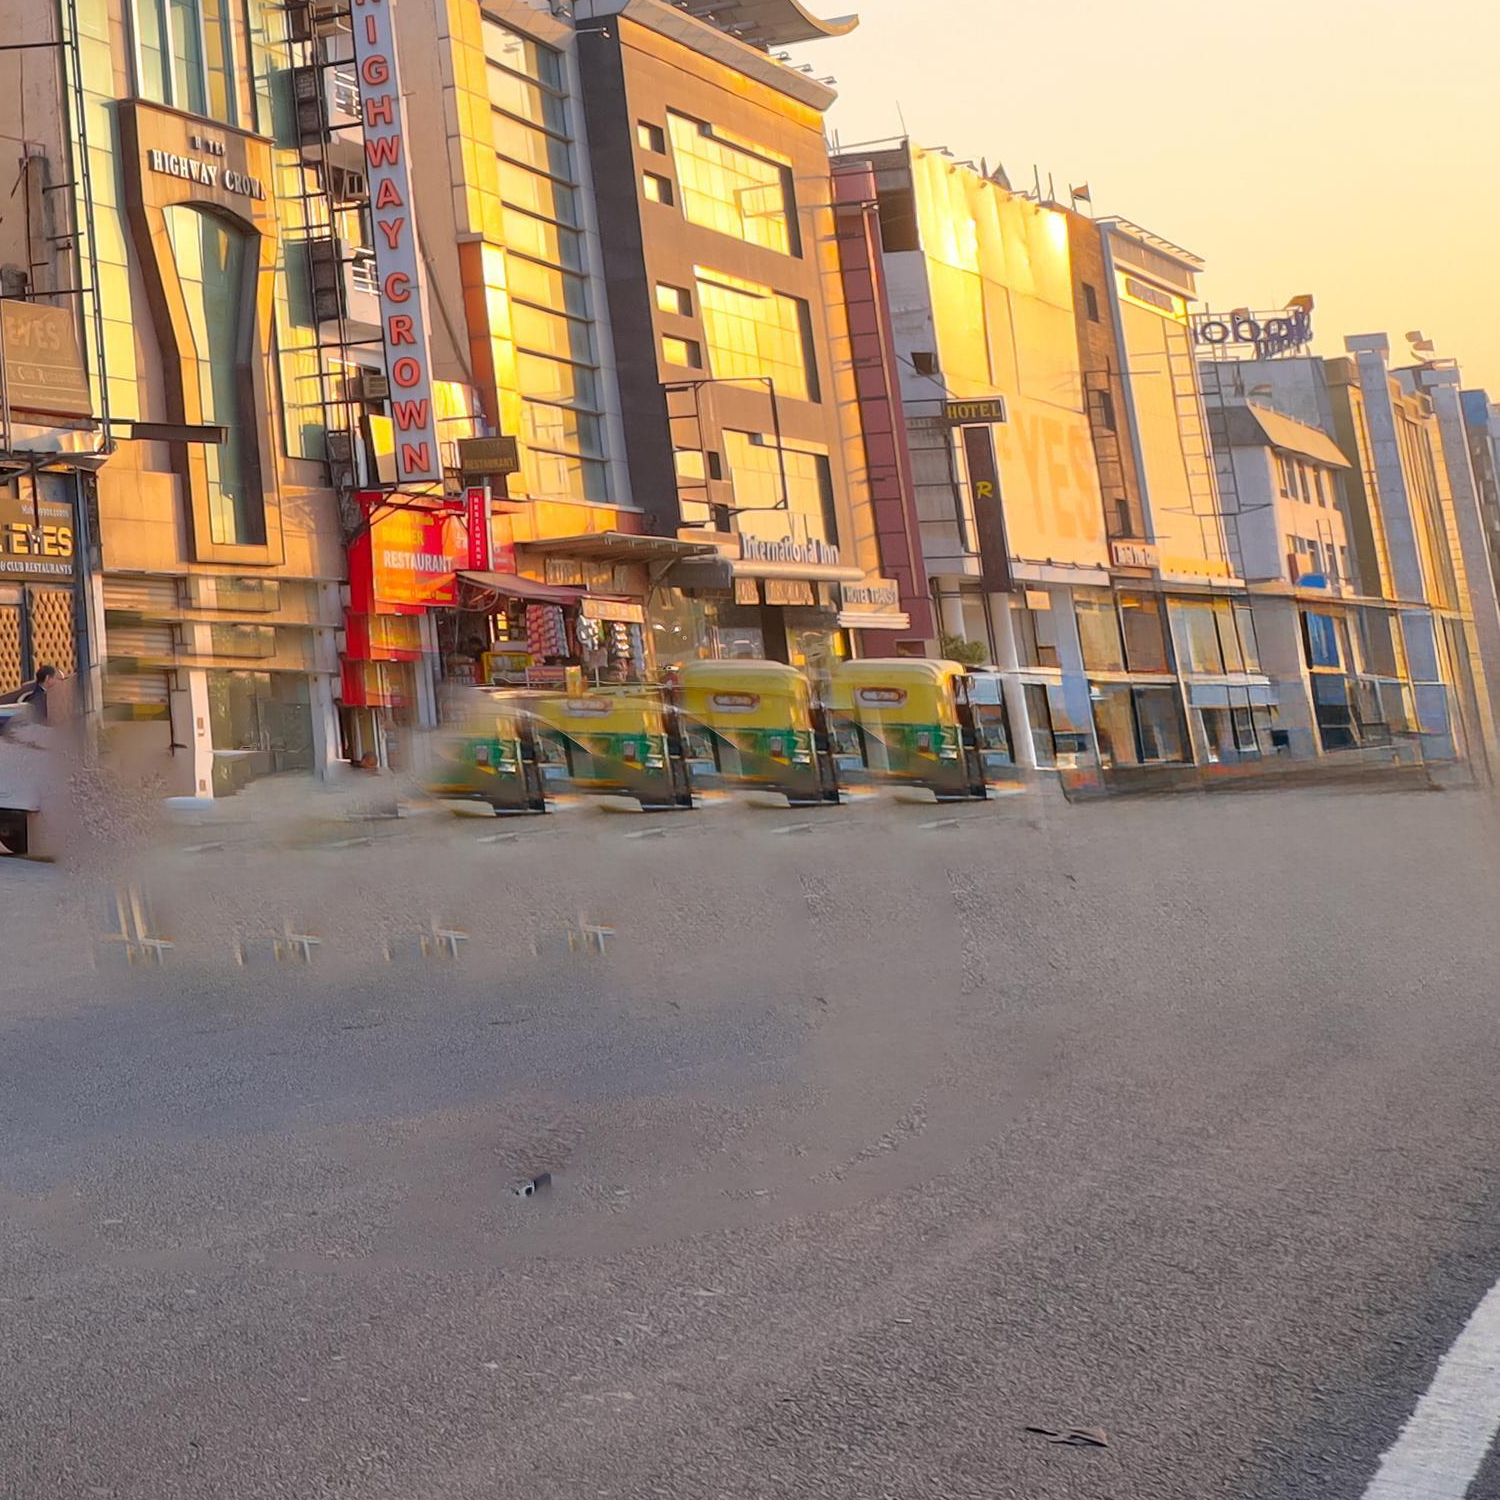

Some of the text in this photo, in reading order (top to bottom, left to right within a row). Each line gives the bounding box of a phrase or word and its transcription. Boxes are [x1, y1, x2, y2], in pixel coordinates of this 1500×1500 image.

[150, 148, 217, 186] HIGHWAY
[383, 270, 430, 474] CROWN
[947, 403, 1000, 419] HOTEL
[976, 481, 993, 499] R
[12, 522, 73, 557] EYES
[741, 532, 840, 565] International Inn
[7, 561, 24, 573] CLUB
[25, 562, 73, 575] RESTAURANTS
[383, 550, 454, 573] RESTAURANT
